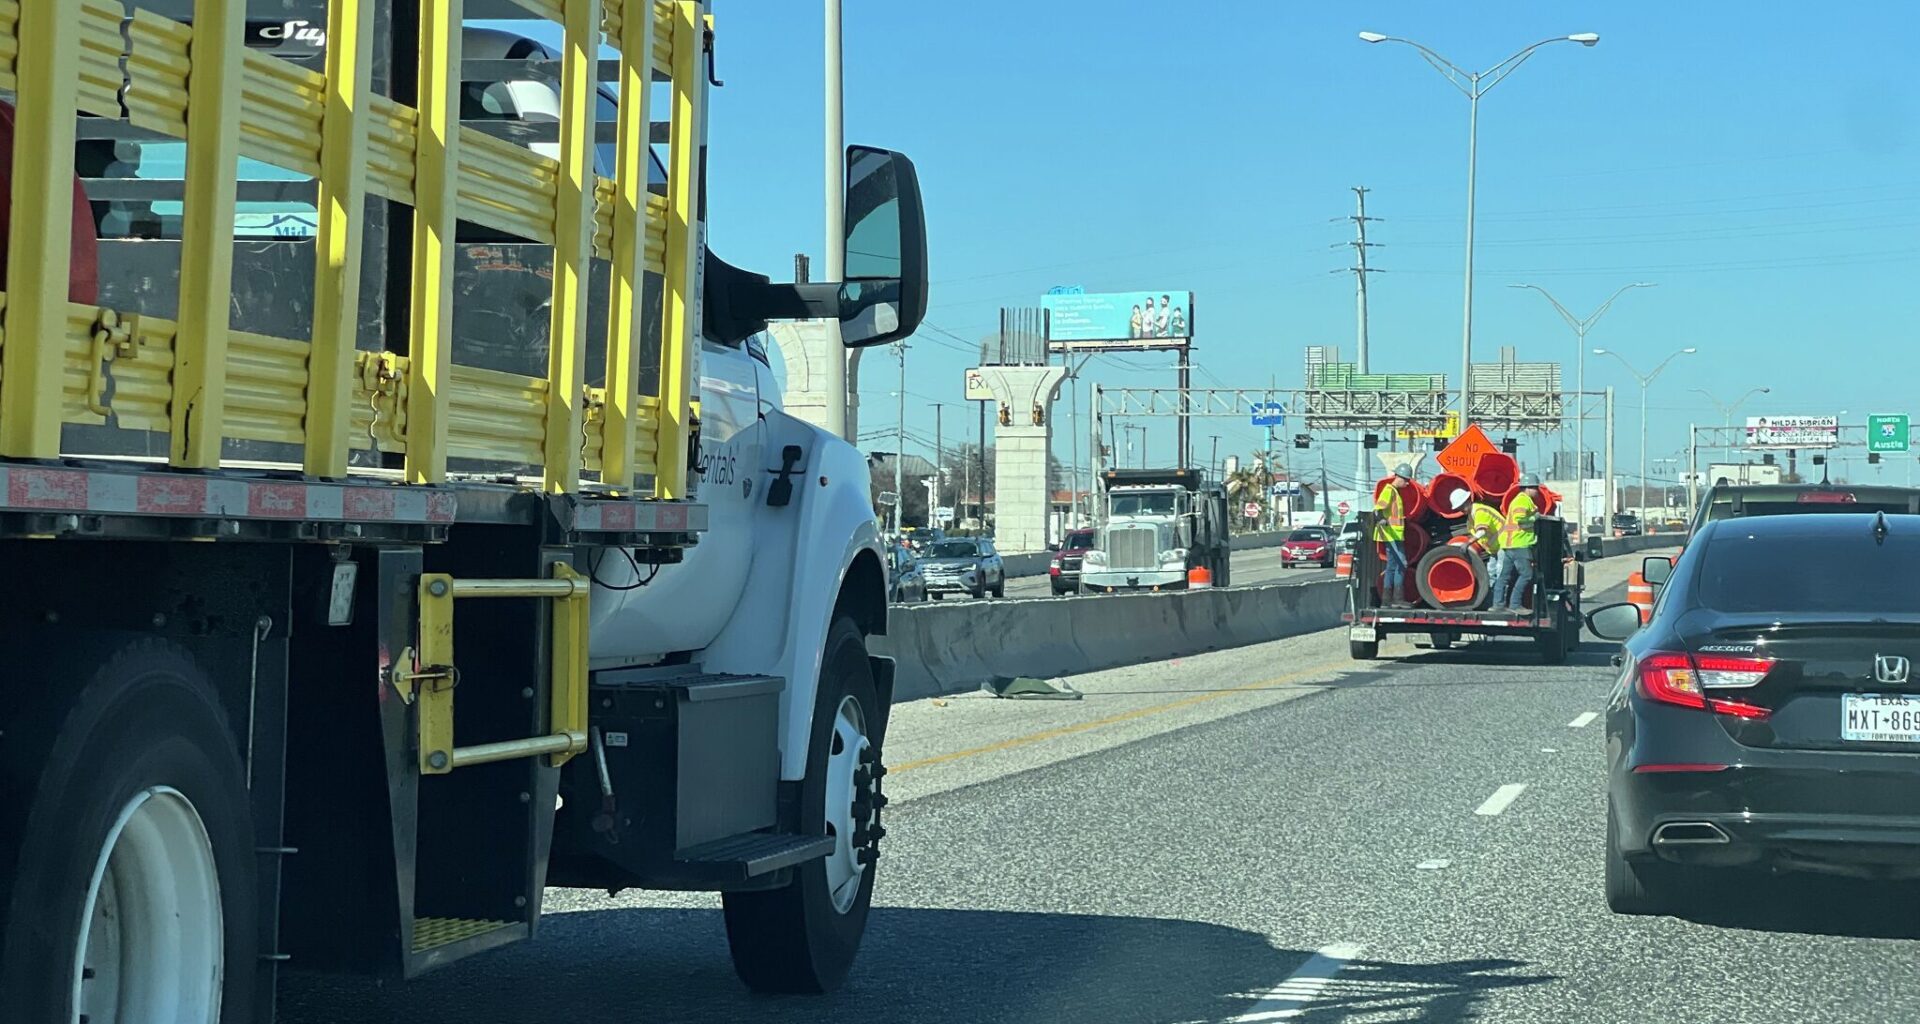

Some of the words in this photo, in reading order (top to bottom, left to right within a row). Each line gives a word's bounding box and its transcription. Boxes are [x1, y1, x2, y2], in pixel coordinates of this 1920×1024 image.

[1466, 443, 1479, 453] NO
[1874, 441, 1904, 449] Austin
[1874, 696, 1911, 706] TEXAS
